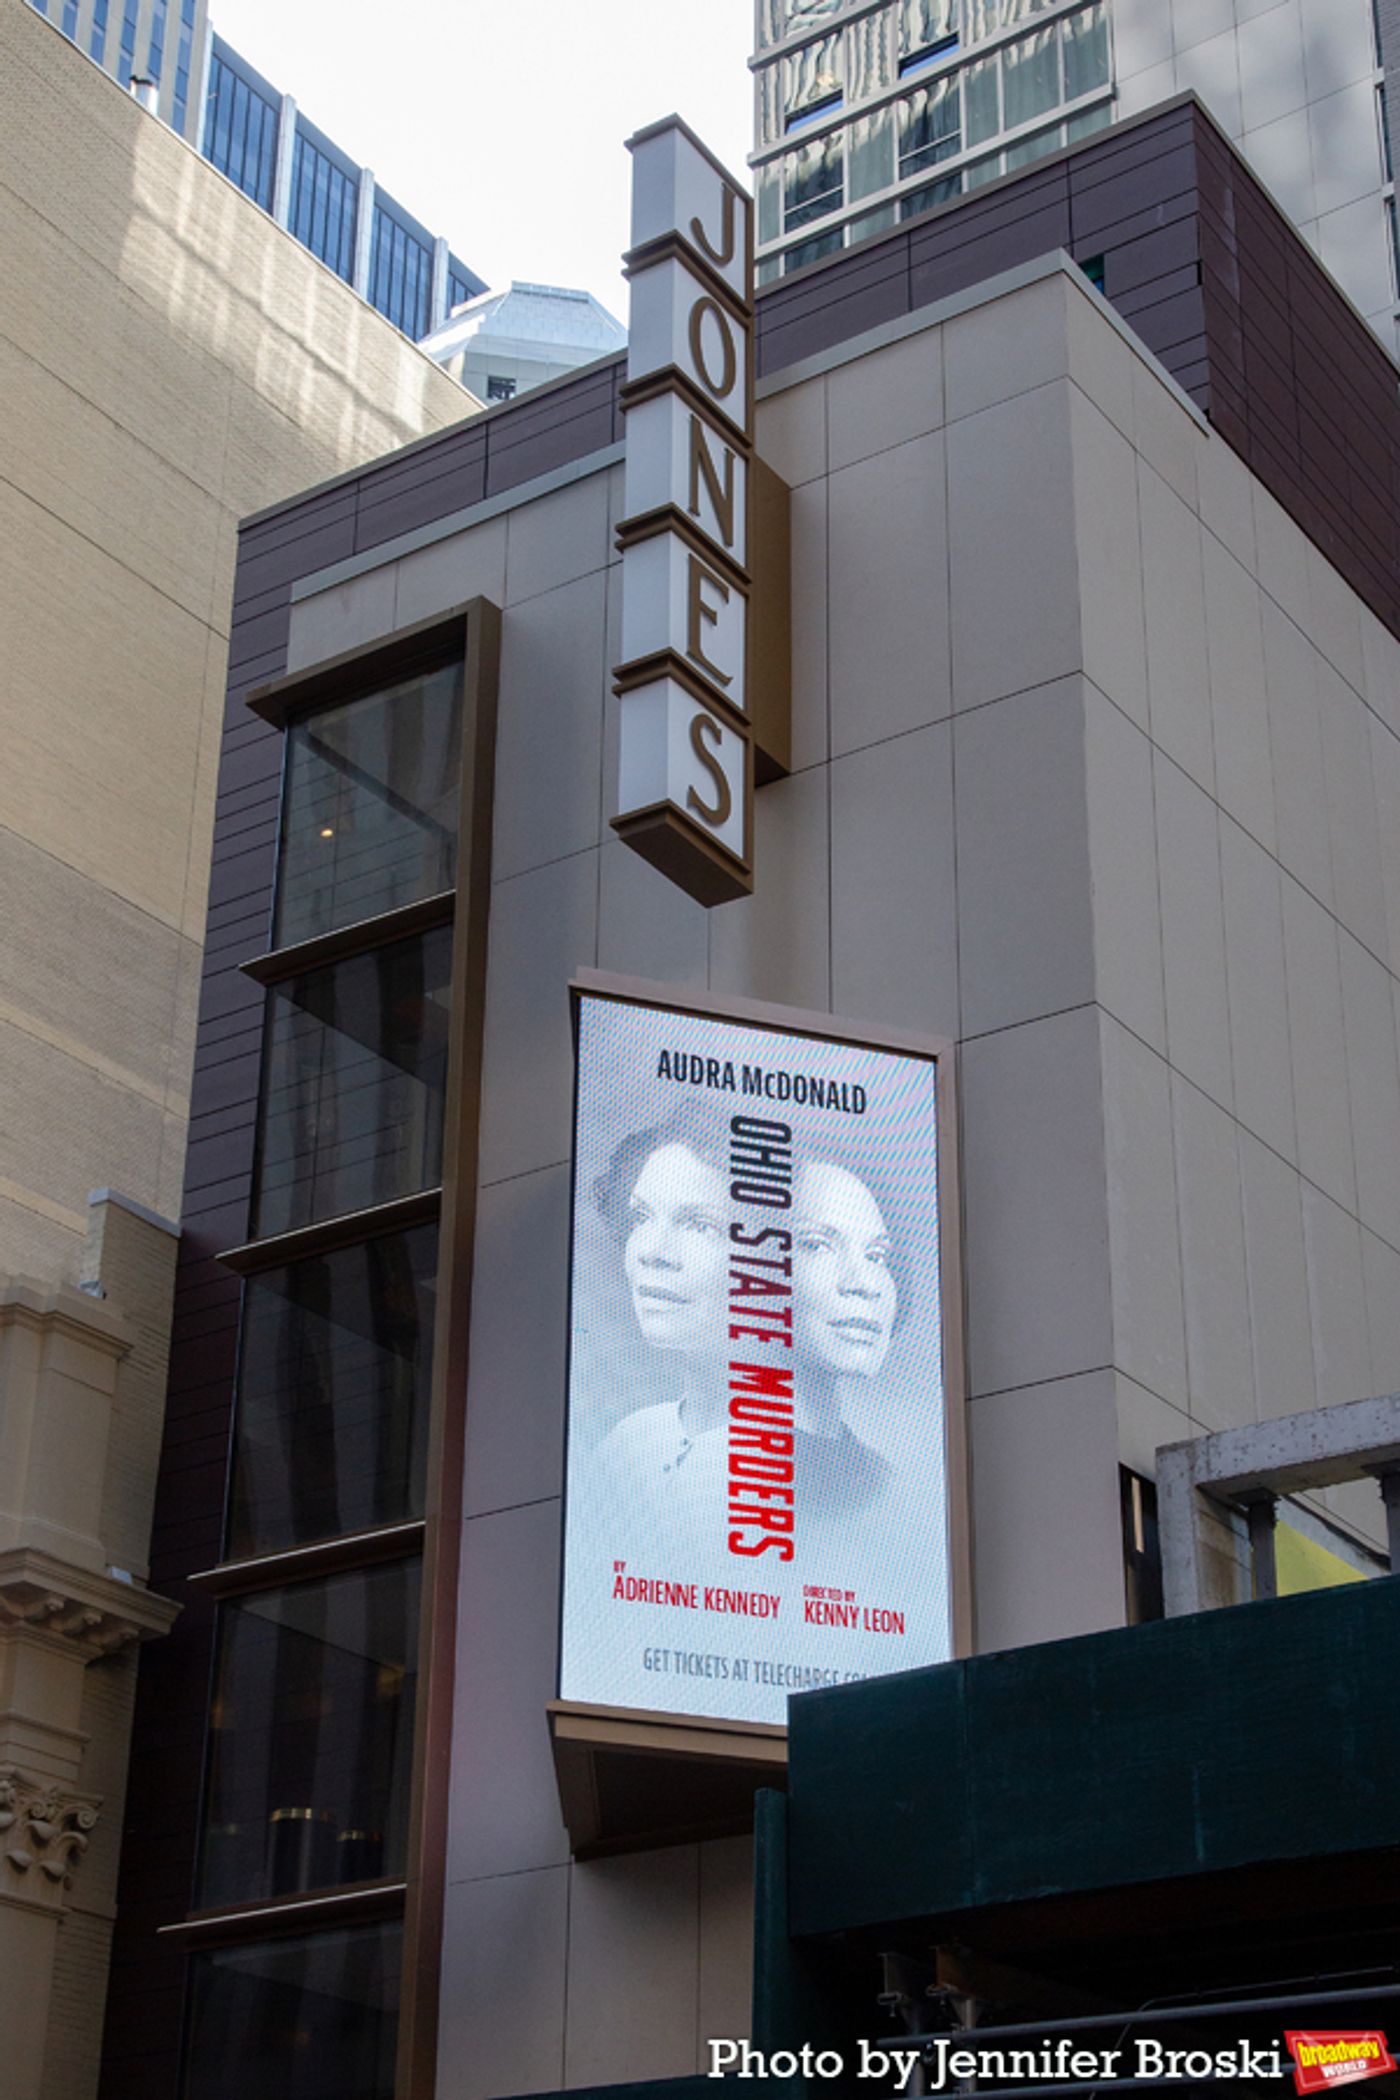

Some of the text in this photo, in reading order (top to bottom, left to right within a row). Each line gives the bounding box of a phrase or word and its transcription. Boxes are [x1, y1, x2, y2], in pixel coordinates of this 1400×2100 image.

[687, 181, 738, 829] JONES
[657, 1048, 867, 1115] AUDRA McDONALD
[728, 1115, 795, 1563] OHIO STATE MURDERS
[613, 1560, 627, 1573] BY
[612, 1575, 781, 1619] ADRIENNE KENNEDY
[803, 1584, 842, 1601] DIRECTED
[804, 1600, 905, 1635] KENNY LEON
[643, 1647, 670, 1672] GET
[674, 1651, 730, 1680] TICKETS
[732, 1659, 749, 1682] AT
